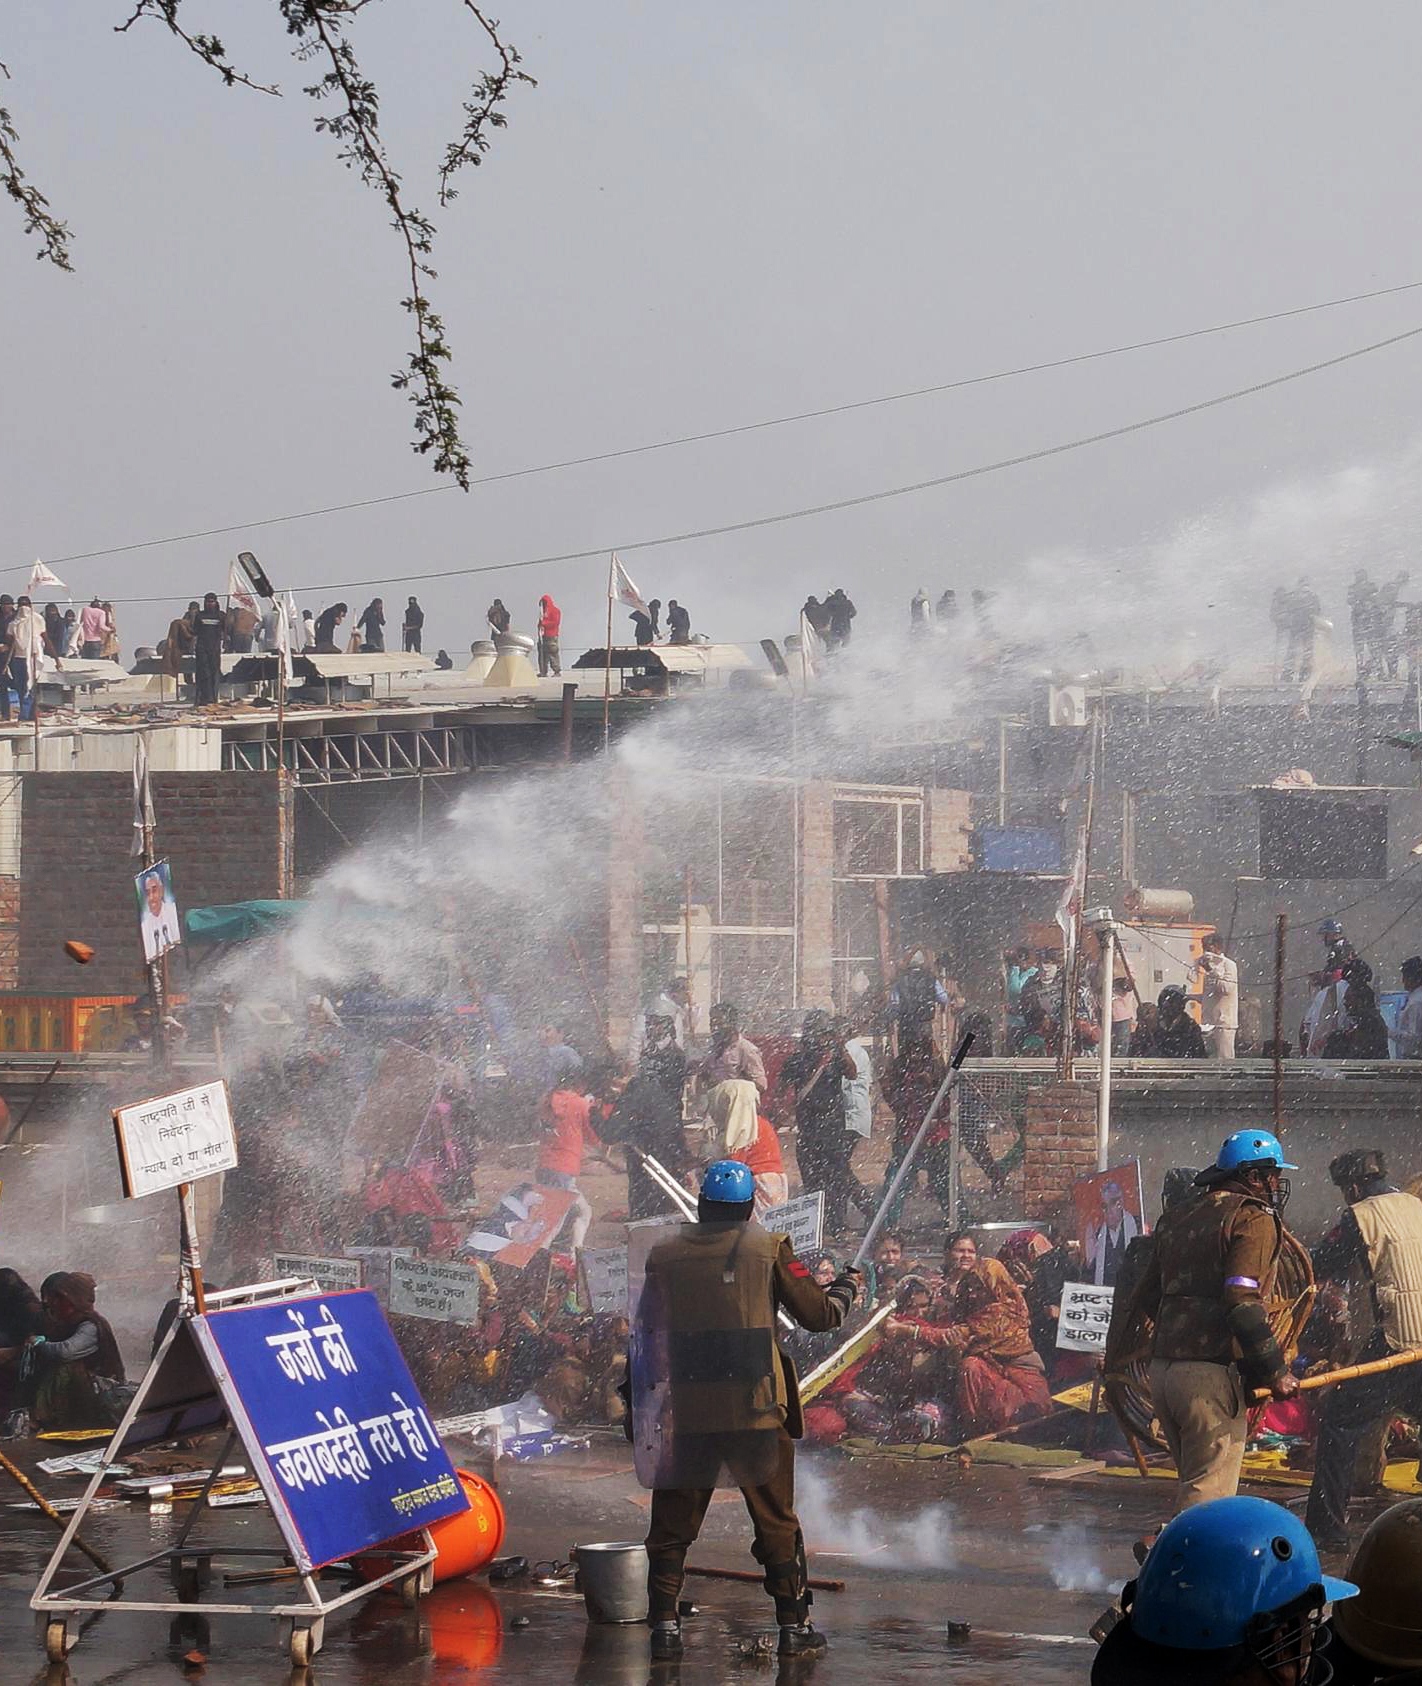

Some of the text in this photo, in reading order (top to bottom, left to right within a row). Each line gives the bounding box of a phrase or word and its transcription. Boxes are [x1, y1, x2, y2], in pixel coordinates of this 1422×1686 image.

[140, 1103, 178, 1125] राष्ट्रपति
[182, 1097, 196, 1111] जी
[171, 1153, 183, 1167] दो
[187, 1150, 199, 1161] या
[1070, 1292, 1102, 1305] भ्रष्ट
[1066, 1308, 1089, 1322] को
[1065, 1328, 1106, 1342] डाला
[265, 1304, 358, 1385] जजों की
[265, 1406, 373, 1491] जवाबदेही
[361, 1417, 406, 1465] तय
